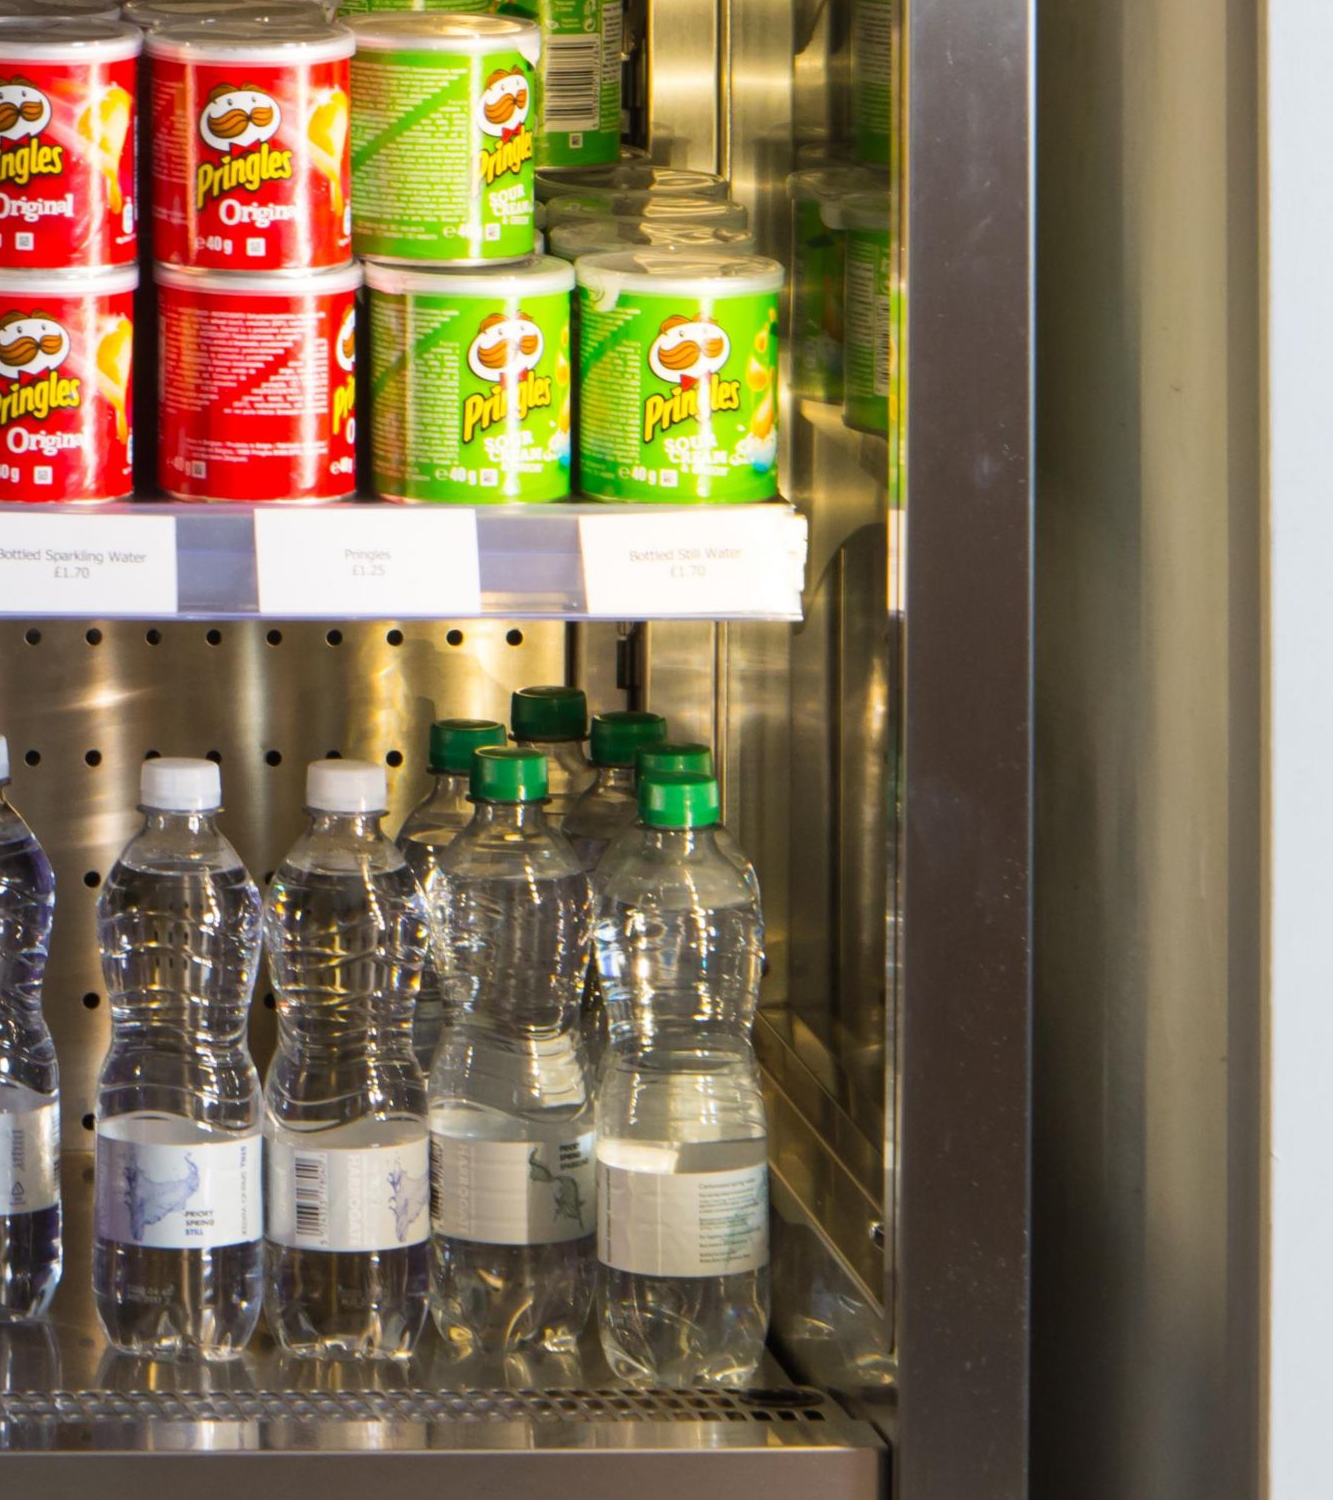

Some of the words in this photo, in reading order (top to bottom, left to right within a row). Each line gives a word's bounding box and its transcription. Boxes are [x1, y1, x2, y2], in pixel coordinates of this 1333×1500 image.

[196, 143, 294, 211] Pringles
[45, 548, 104, 564] Sparkling
[109, 550, 147, 563] Water
[345, 548, 392, 562] Pringles
[54, 567, 90, 579] £1.70
[352, 565, 386, 577] £1.25
